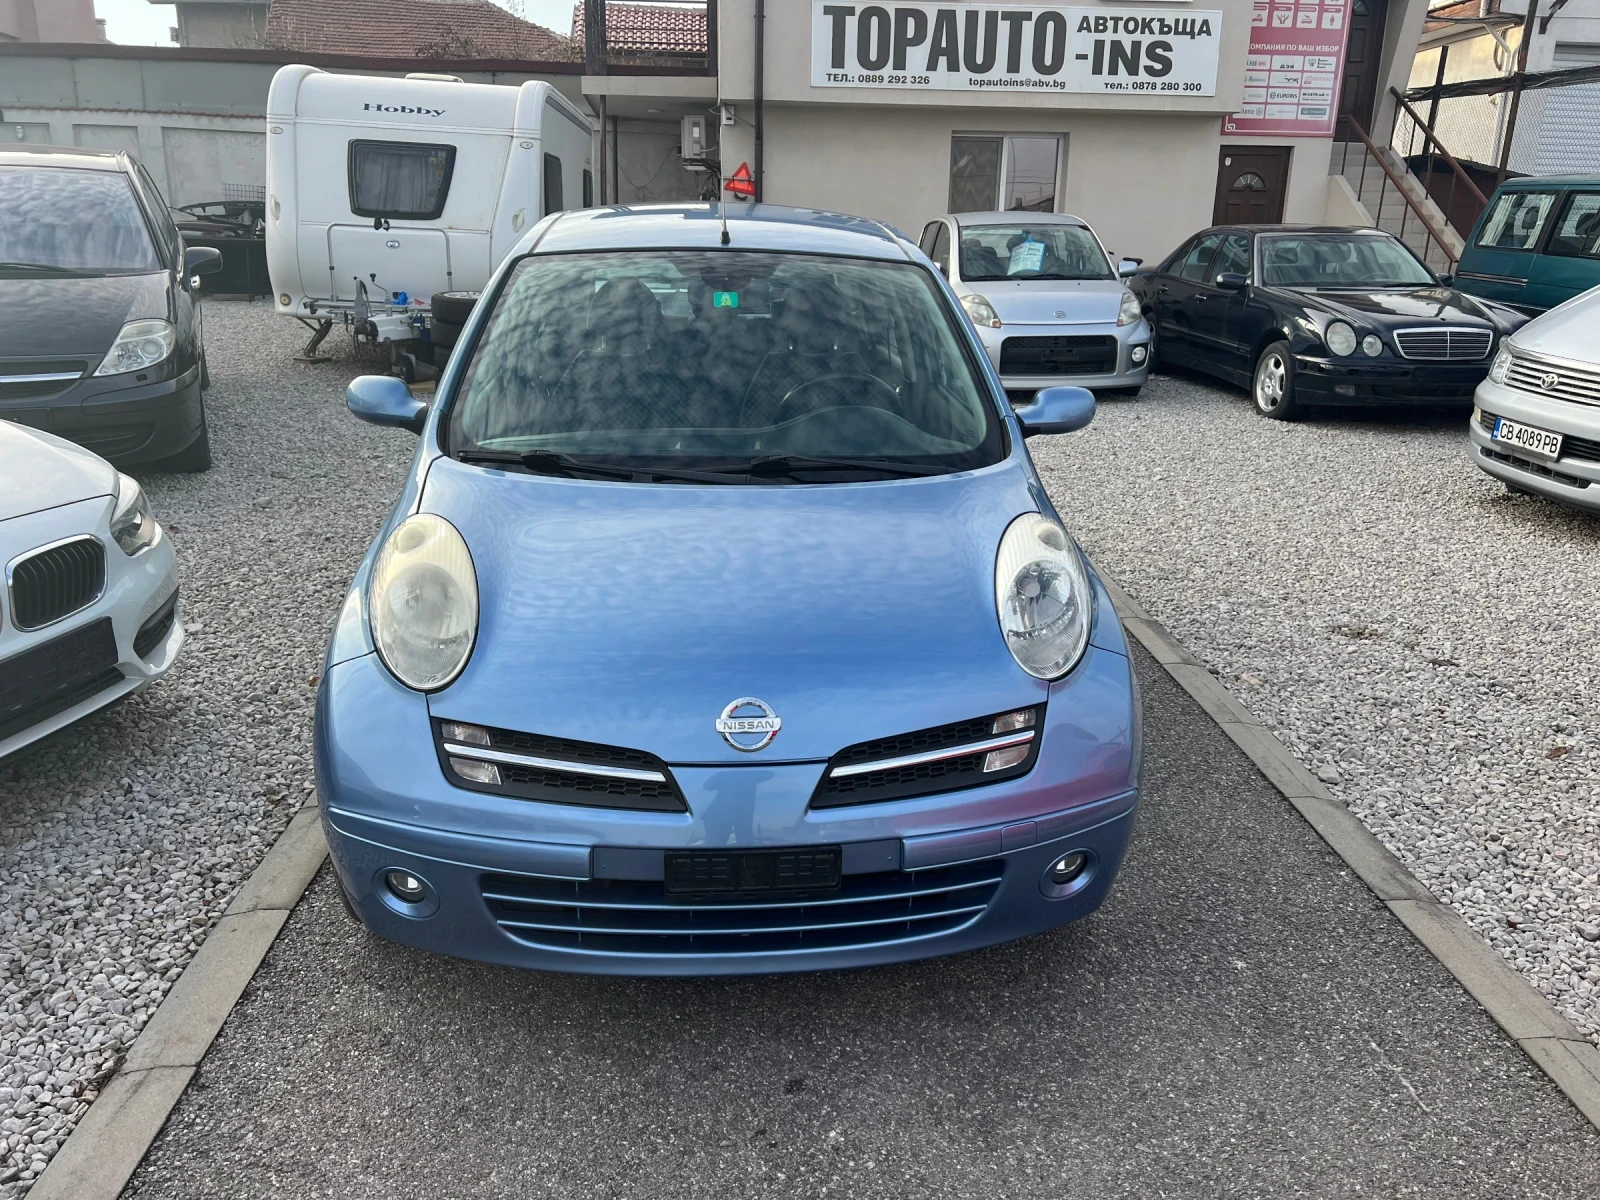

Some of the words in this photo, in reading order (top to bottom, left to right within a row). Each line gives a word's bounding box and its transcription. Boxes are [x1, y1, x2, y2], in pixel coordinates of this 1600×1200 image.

[1076, 15, 1212, 39] АВТОКЪЩА
[823, 5, 1067, 75] TOPAUTO
[1298, 44, 1315, 52] ВАШ
[826, 73, 854, 82] ТЕЛ.:
[858, 74, 884, 83] 0889
[887, 75, 907, 84] 292
[910, 75, 930, 84] 326
[969, 77, 1066, 89] topautoins@abv.bg
[1104, 82, 1129, 90] тел.:
[1132, 82, 1157, 90] 0878
[1160, 82, 1180, 91] 280
[1182, 83, 1202, 91] 300
[363, 103, 446, 117] Hobby
[1500, 423, 1514, 440] CB
[1516, 428, 1542, 448] 4089
[1542, 435, 1558, 453] PB
[723, 720, 774, 730] NISSAN
